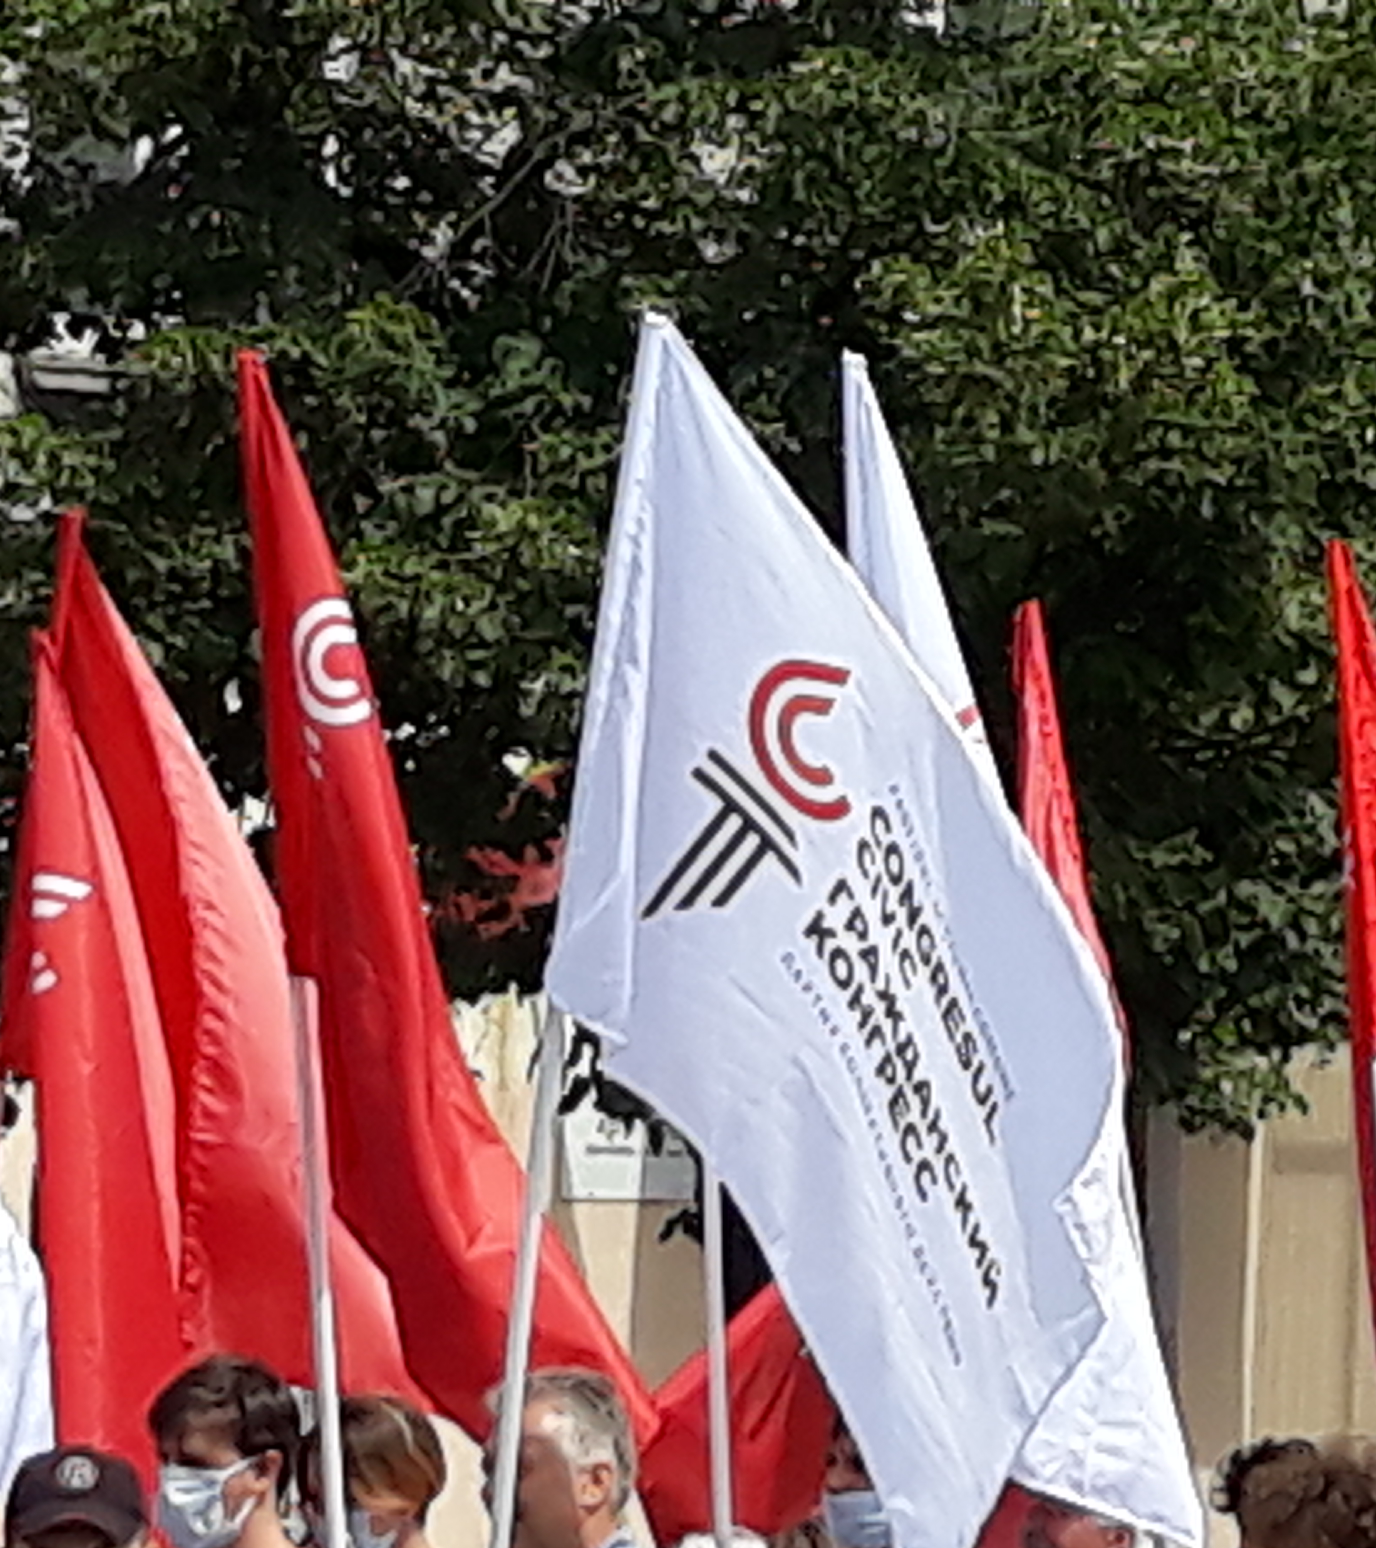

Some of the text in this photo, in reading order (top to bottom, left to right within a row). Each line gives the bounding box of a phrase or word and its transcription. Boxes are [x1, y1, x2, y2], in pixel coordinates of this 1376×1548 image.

[802, 909, 938, 1204] КОНГРЕСС
[855, 837, 918, 990] CIVIC
[870, 804, 999, 1147] CONGRESUL
[827, 877, 1002, 1310] ГРАЖДАНСКИЙ
